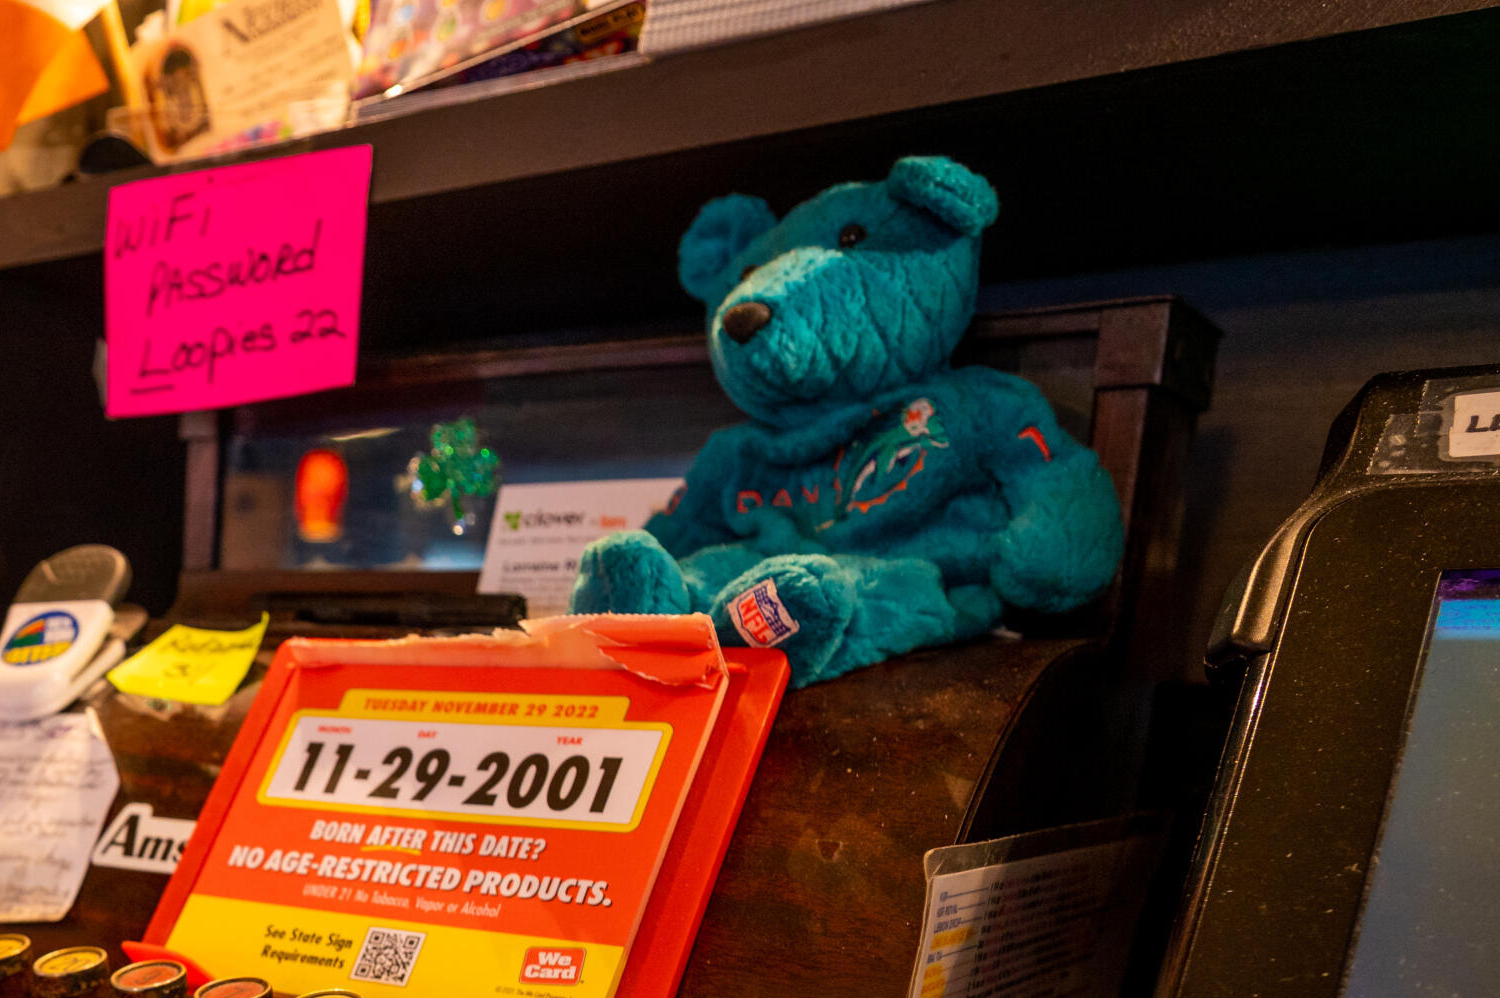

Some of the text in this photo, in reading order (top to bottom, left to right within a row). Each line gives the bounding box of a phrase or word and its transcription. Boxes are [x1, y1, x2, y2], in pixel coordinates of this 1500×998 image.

[739, 595, 770, 644] NFL
[363, 697, 600, 720] TUESDAY NOVEMBER 29 2022
[317, 725, 583, 746] MONTH DAY YEAR
[293, 741, 624, 815] 11-29-2001
[310, 819, 547, 861] BORN AFTER THIS DATE?
[228, 845, 613, 907] NO AGE-RESTRICTED PRODUCTS.
[302, 883, 337, 900] UNDER
[338, 886, 350, 901] 21
[354, 889, 368, 903] No
[415, 895, 444, 913] Vapor
[446, 901, 458, 913] or
[460, 899, 502, 918] Alcohol
[264, 924, 353, 952] See State Sign
[261, 944, 346, 969] Requirements
[537, 951, 572, 966] We
[524, 964, 577, 980] Card
